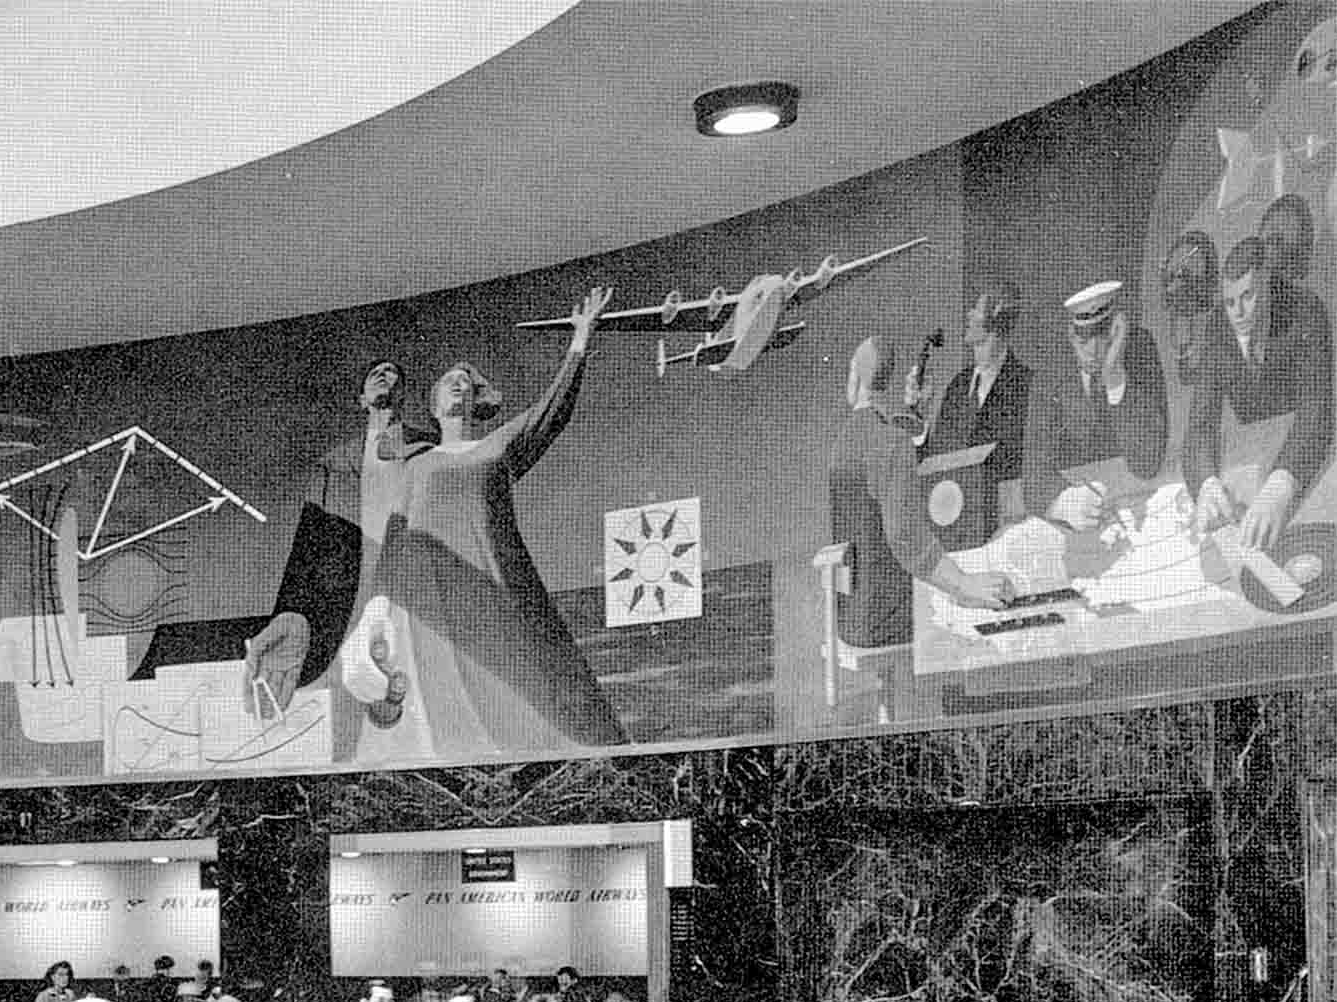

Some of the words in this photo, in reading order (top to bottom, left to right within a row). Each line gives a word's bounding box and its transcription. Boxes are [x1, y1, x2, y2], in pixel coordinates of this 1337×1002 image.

[425, 891, 454, 905] PAN
[458, 890, 527, 904] AMERICAN
[532, 889, 582, 903] WORLD
[585, 888, 647, 902] AIRWAYS
[4, 901, 49, 913] WORLD
